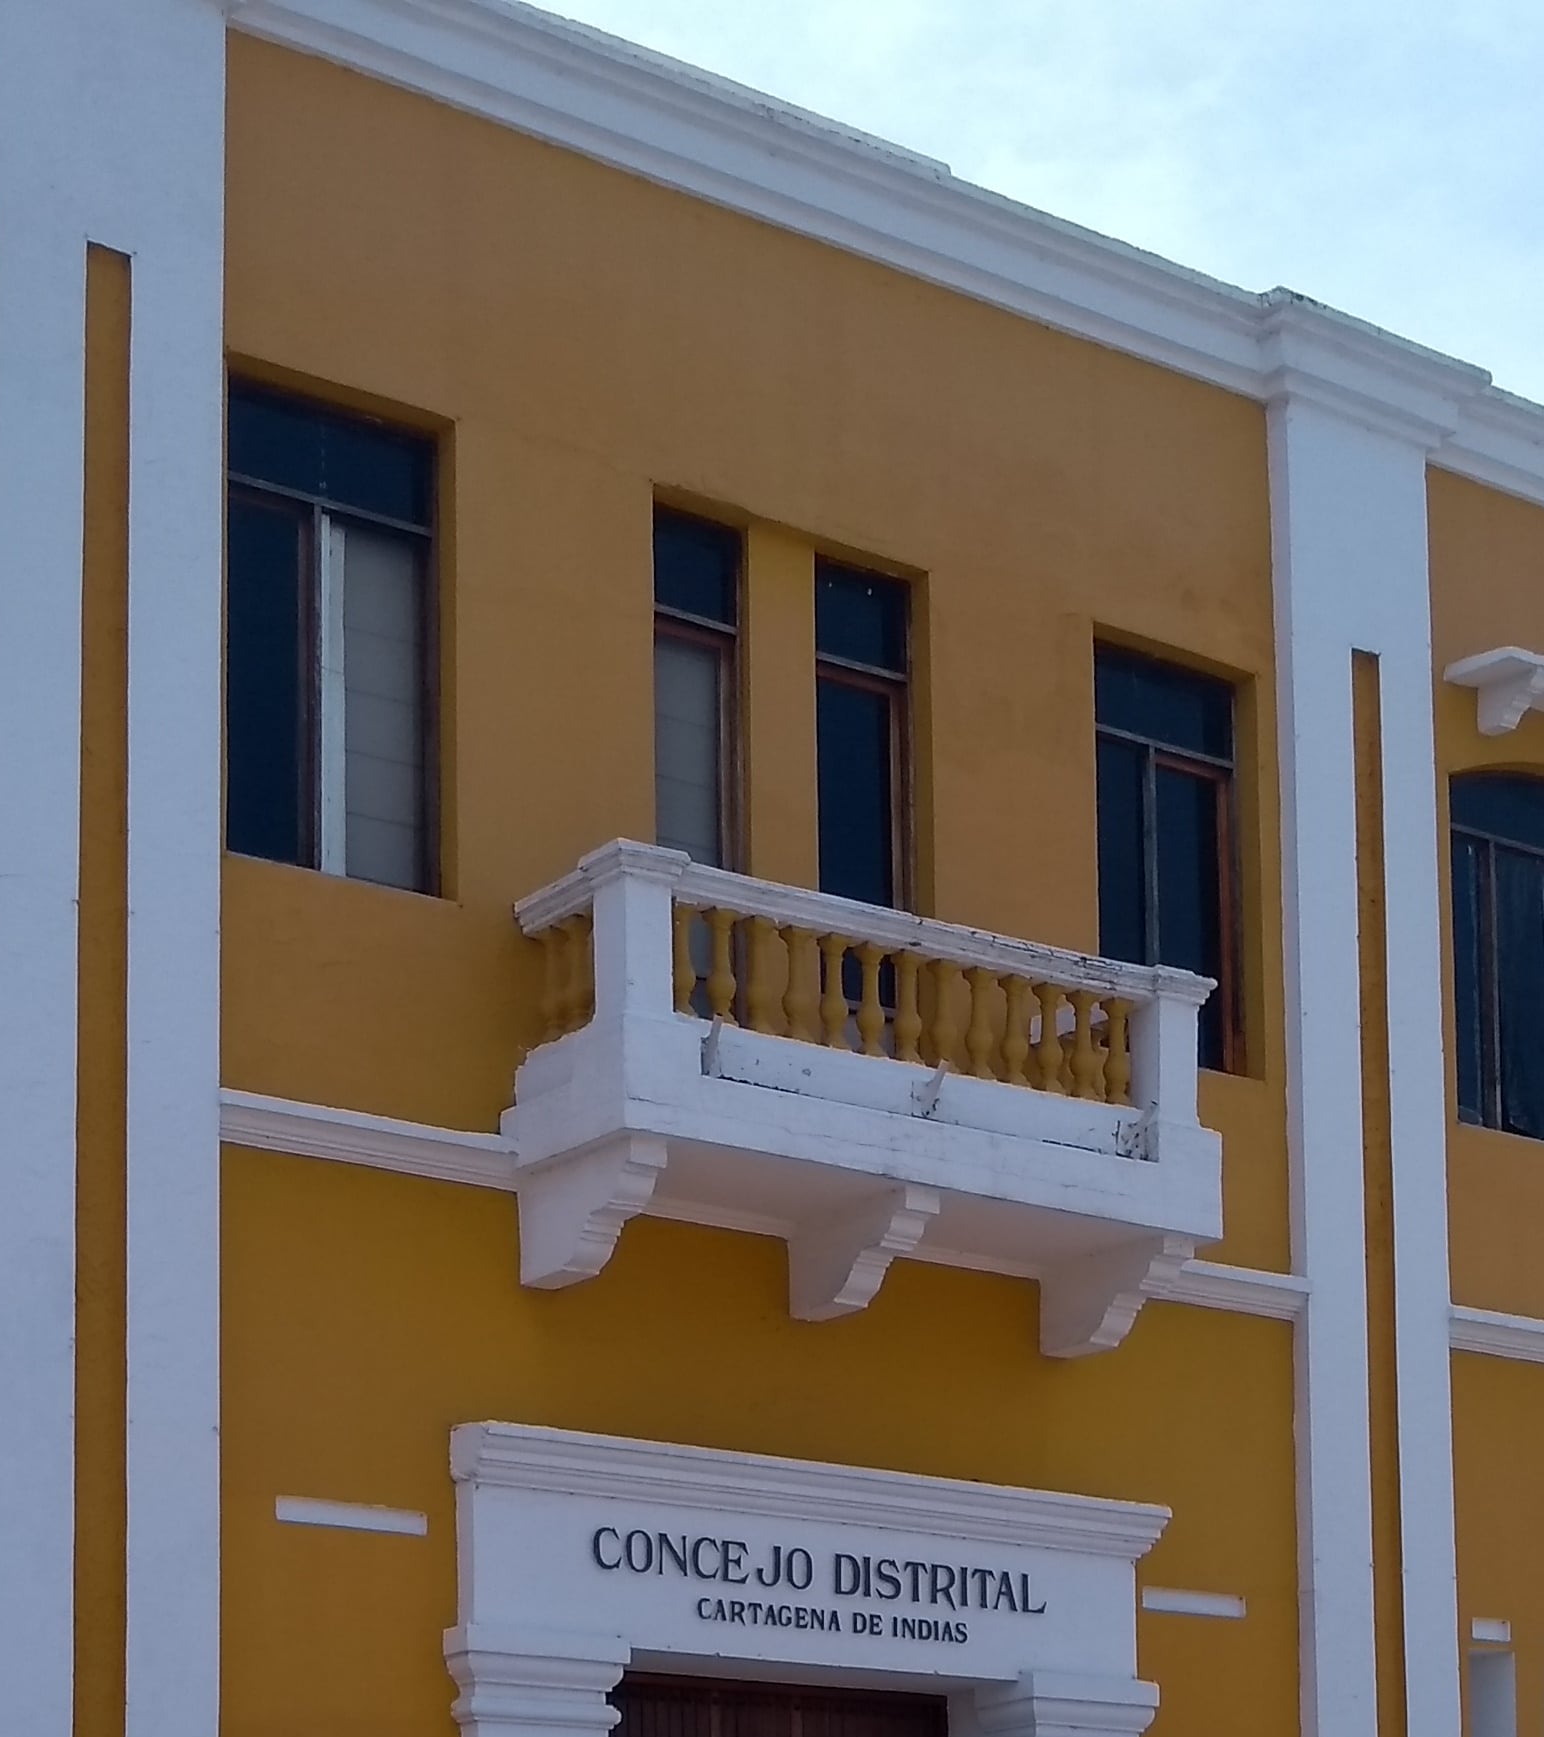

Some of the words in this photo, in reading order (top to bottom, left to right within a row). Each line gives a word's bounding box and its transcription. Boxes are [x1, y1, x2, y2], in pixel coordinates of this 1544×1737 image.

[592, 1526, 814, 1590] CONCEJO
[834, 1553, 1047, 1614] DISTRITAL
[696, 1597, 842, 1633] CARTAGENA
[852, 1611, 884, 1637] DE
[892, 1616, 969, 1645] INDIAS
